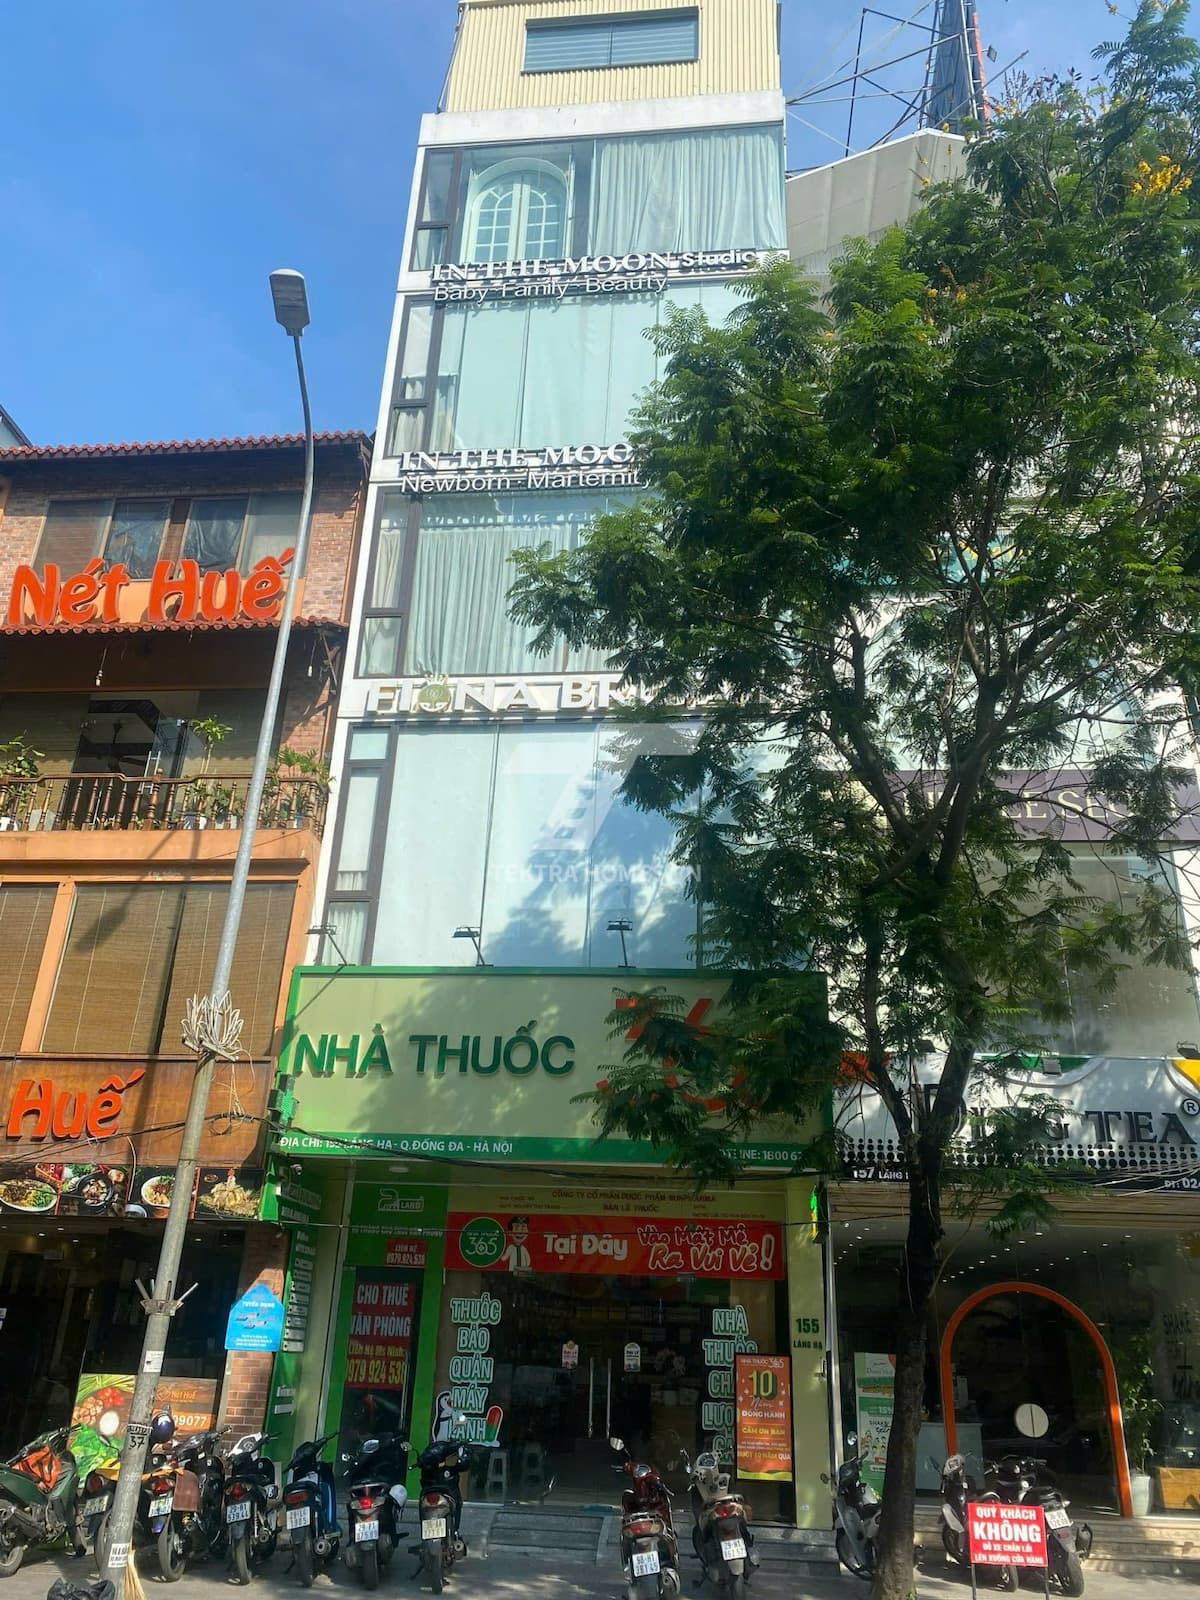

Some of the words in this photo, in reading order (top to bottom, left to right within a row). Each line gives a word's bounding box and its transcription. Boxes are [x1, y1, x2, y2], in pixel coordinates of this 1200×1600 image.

[432, 263, 468, 281] IN
[477, 259, 550, 280] THE
[562, 252, 671, 274] MOON
[434, 285, 488, 304] Baby
[501, 280, 569, 300] Family
[586, 275, 668, 294] Beauty
[400, 451, 440, 470] IN
[453, 447, 527, 469] THE
[543, 443, 634, 465] MOO
[401, 474, 511, 493] Newborn
[8, 557, 130, 625] Nét
[149, 547, 297, 621] Huế
[292, 1023, 393, 1077] NHÀ
[409, 1020, 575, 1075] THUỐC
[6, 1068, 146, 1140] Huế
[1084, 1111, 1198, 1146] TEA
[280, 1137, 299, 1149] ĐỊA
[852, 1166, 875, 1179] 157
[465, 1236, 498, 1256] 365
[543, 1233, 577, 1260] Tại
[582, 1233, 628, 1261] Đây
[649, 1243, 685, 1270] Ra
[690, 1244, 724, 1271] Vui
[357, 1284, 379, 1305] CHO
[382, 1282, 409, 1306] THUÊ
[452, 1292, 501, 1323] THUỐC
[351, 1312, 371, 1336] VĂN
[374, 1312, 412, 1337] PHÒNG
[713, 1305, 748, 1335] NHÀ
[795, 1318, 820, 1334] 155
[458, 1324, 489, 1351] BẢO
[346, 1359, 366, 1382] 979
[451, 1353, 493, 1382] QUẢN
[749, 1370, 775, 1398] 10
[452, 1385, 488, 1412] MÁY
[129, 1436, 145, 1450] 37
[976, 1506, 997, 1519] QUÝ
[1000, 1506, 1036, 1520] KHÁCH
[973, 1520, 1041, 1542] KHÔNG
